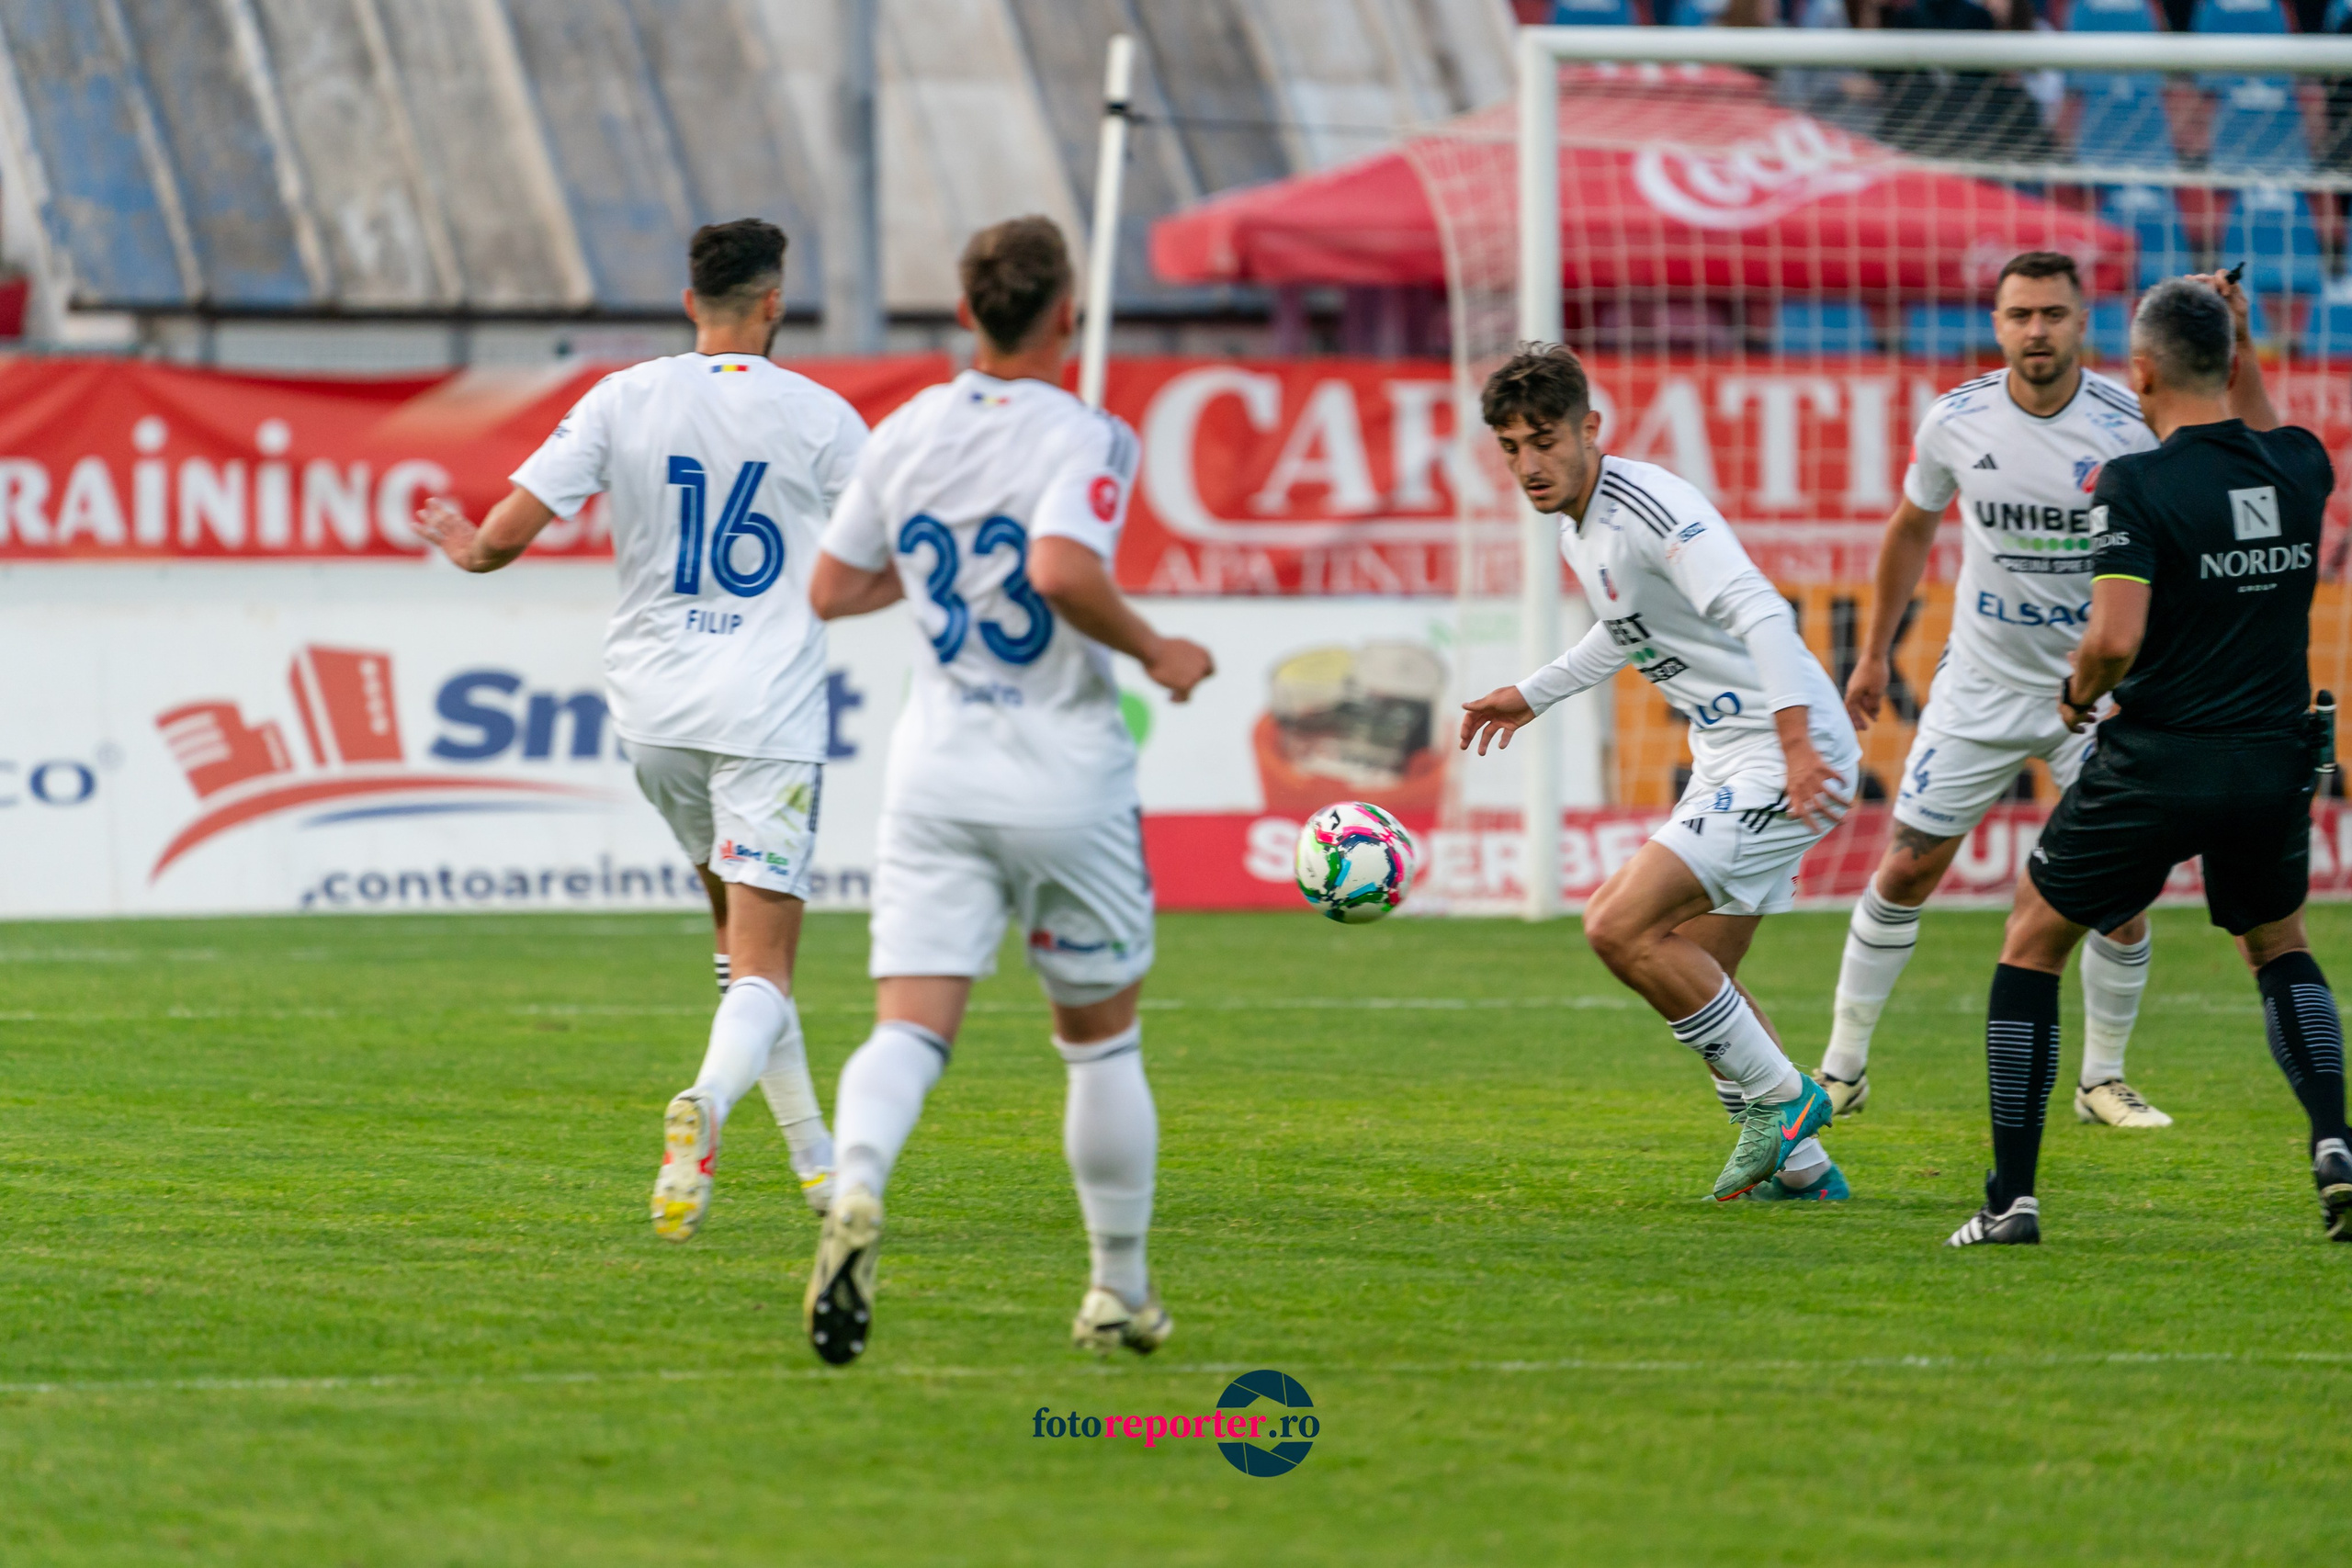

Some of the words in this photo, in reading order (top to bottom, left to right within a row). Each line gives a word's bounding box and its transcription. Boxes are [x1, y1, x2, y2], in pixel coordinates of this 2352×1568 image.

[1633, 116, 1874, 230] Coca
[667, 454, 786, 598] 16
[1976, 500, 2091, 534] UNIBE
[899, 513, 1055, 665] 33
[2200, 543, 2312, 580] NORDIS
[685, 609, 743, 635] FILIP
